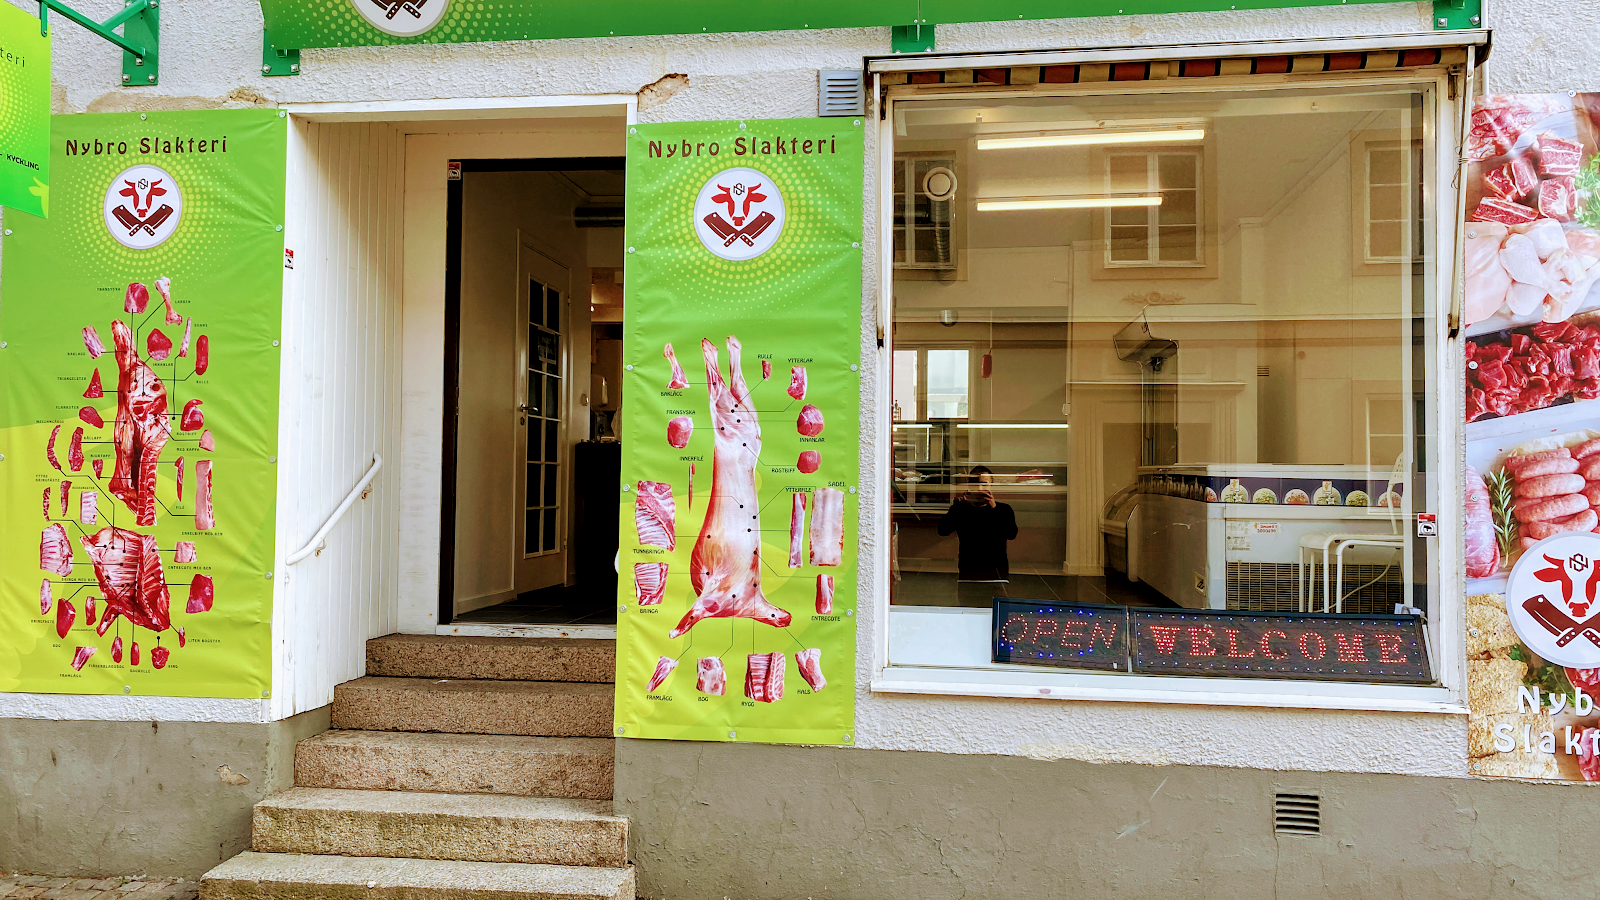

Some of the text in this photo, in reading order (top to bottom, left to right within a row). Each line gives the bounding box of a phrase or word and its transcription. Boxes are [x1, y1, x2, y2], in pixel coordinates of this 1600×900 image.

[66, 135, 228, 156] Nybro Slakteri
[648, 134, 836, 158] Nybro Slakteri
[6, 153, 40, 171] KYCKLING
[827, 480, 846, 488] SADEL
[1001, 616, 1118, 649] OPEN
[1149, 625, 1408, 664] WELCOME
[796, 688, 811, 696] HALS
